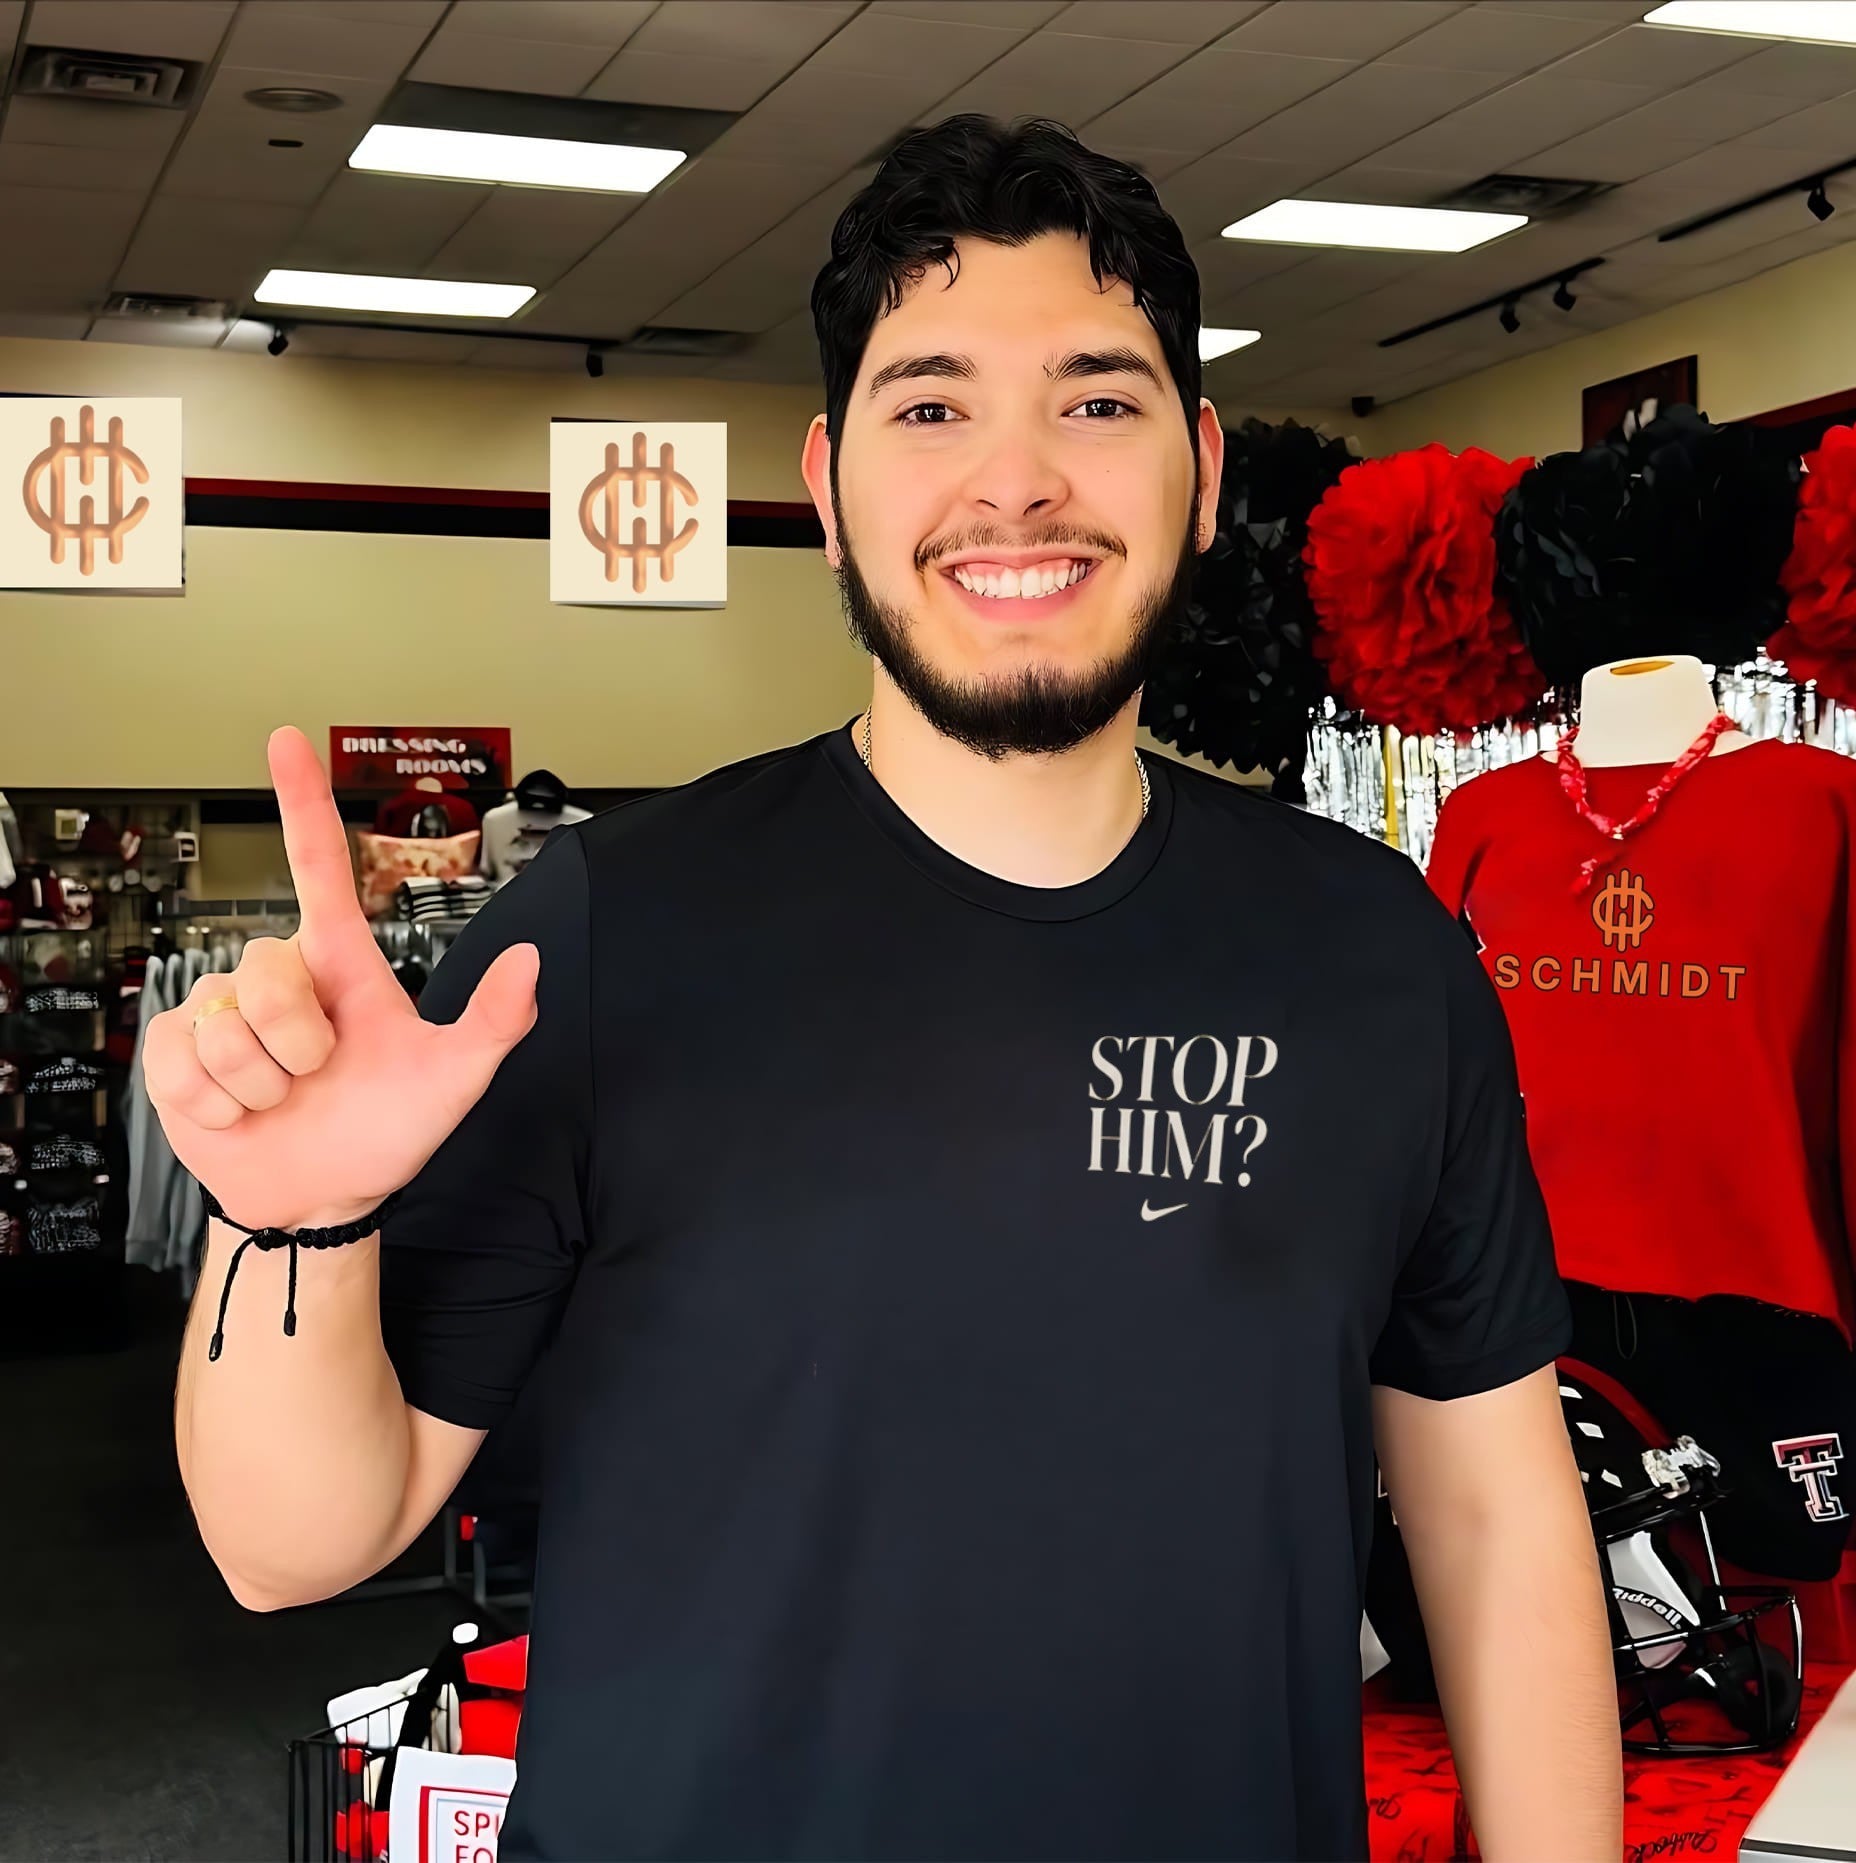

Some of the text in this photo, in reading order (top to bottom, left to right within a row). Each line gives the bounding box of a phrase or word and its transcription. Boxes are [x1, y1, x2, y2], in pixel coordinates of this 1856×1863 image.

[342, 737, 467, 754] DRESSING
[396, 758, 487, 775] ROOMS
[1494, 953, 1747, 1001] SCHMIDT
[1088, 1034, 1279, 1107] STOP
[1087, 1106, 1268, 1188] HIM?
